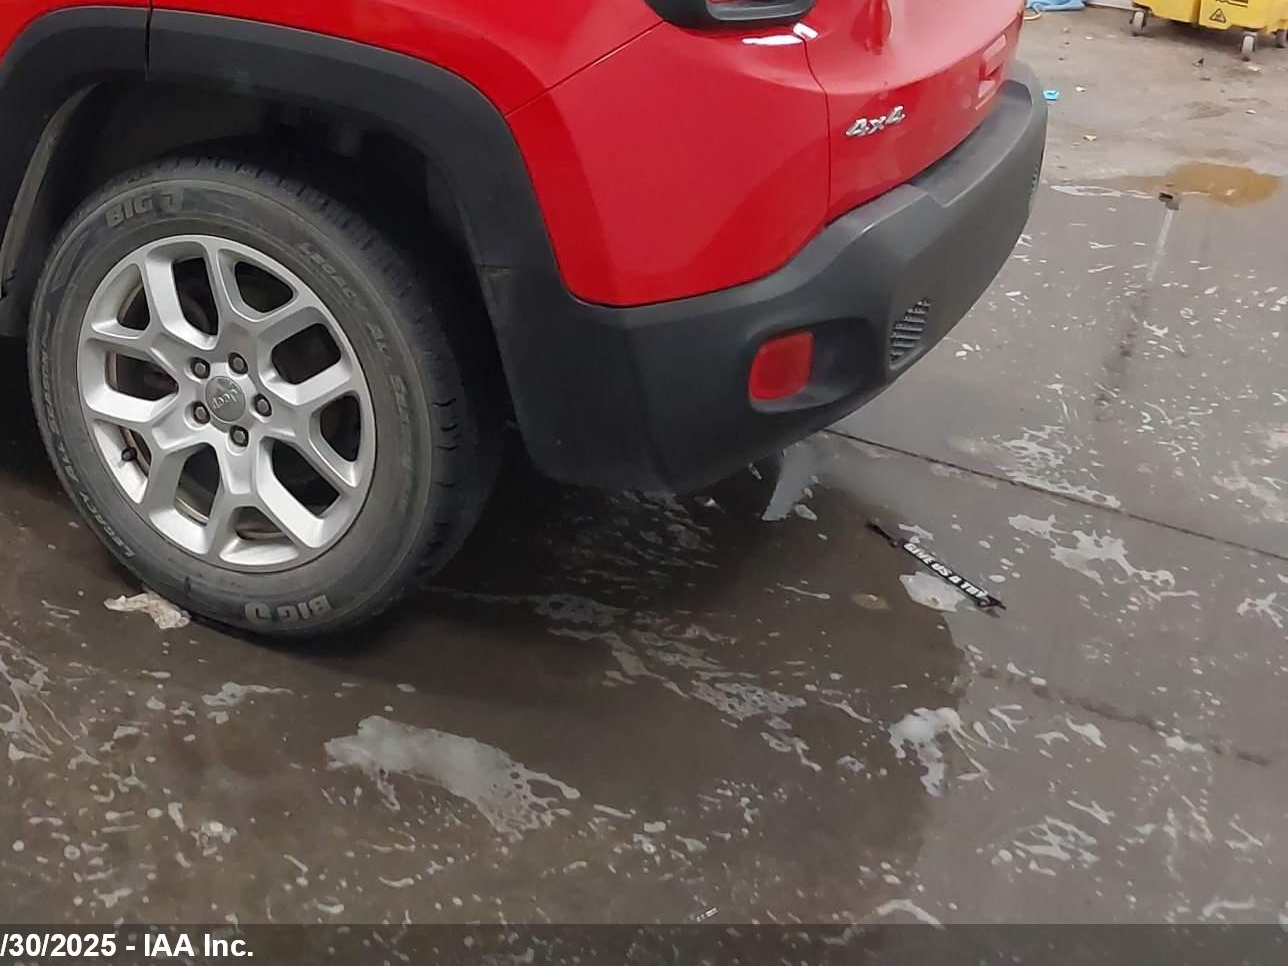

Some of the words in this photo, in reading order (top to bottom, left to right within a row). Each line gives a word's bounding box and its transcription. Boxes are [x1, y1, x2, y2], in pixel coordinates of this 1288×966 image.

[845, 105, 906, 138] 4x4
[105, 193, 153, 227] BIG
[903, 542, 936, 565] GIVE
[931, 562, 953, 577] US
[276, 594, 332, 622] BIG
